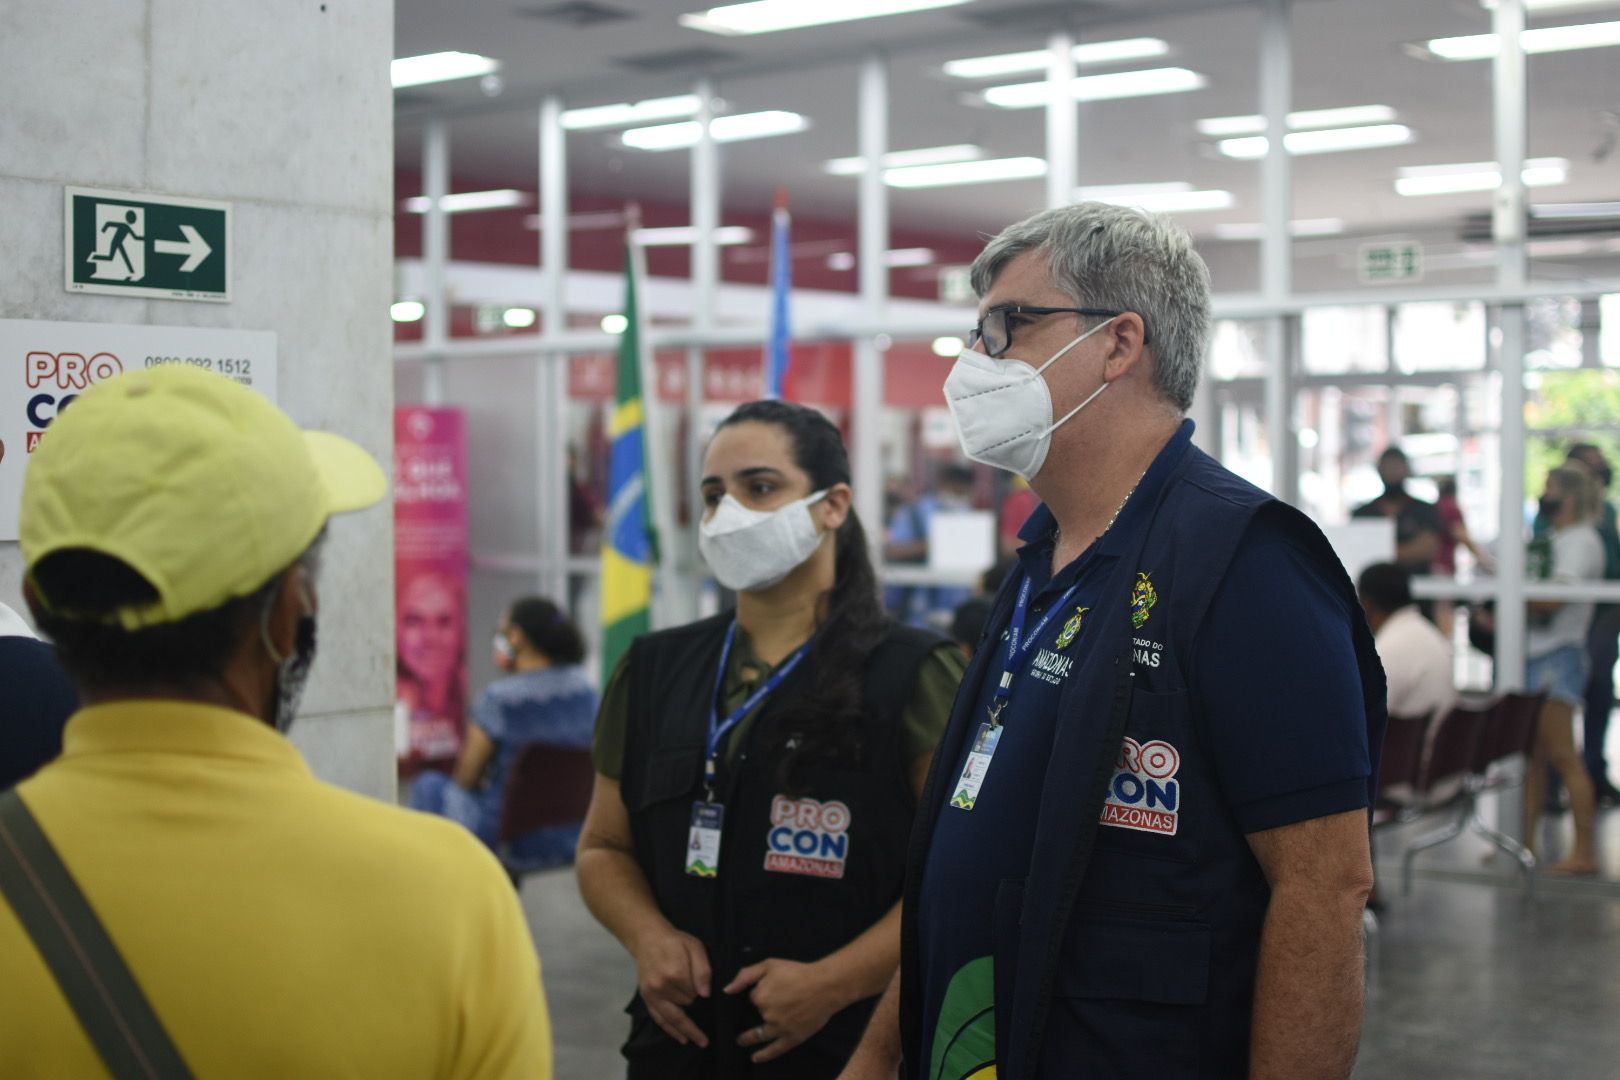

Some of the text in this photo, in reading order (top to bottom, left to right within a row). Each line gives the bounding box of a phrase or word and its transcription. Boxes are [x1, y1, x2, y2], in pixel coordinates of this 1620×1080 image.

[26, 351, 123, 390] PRO
[217, 358, 251, 375] 1512
[1132, 637, 1164, 651] TADO DO
[1132, 648, 1161, 668] NAS
[1115, 737, 1178, 779] RO
[1107, 772, 1177, 812] ON
[770, 794, 851, 833] PRO
[770, 827, 847, 859] CON
[769, 855, 842, 874] AMAZONAS
